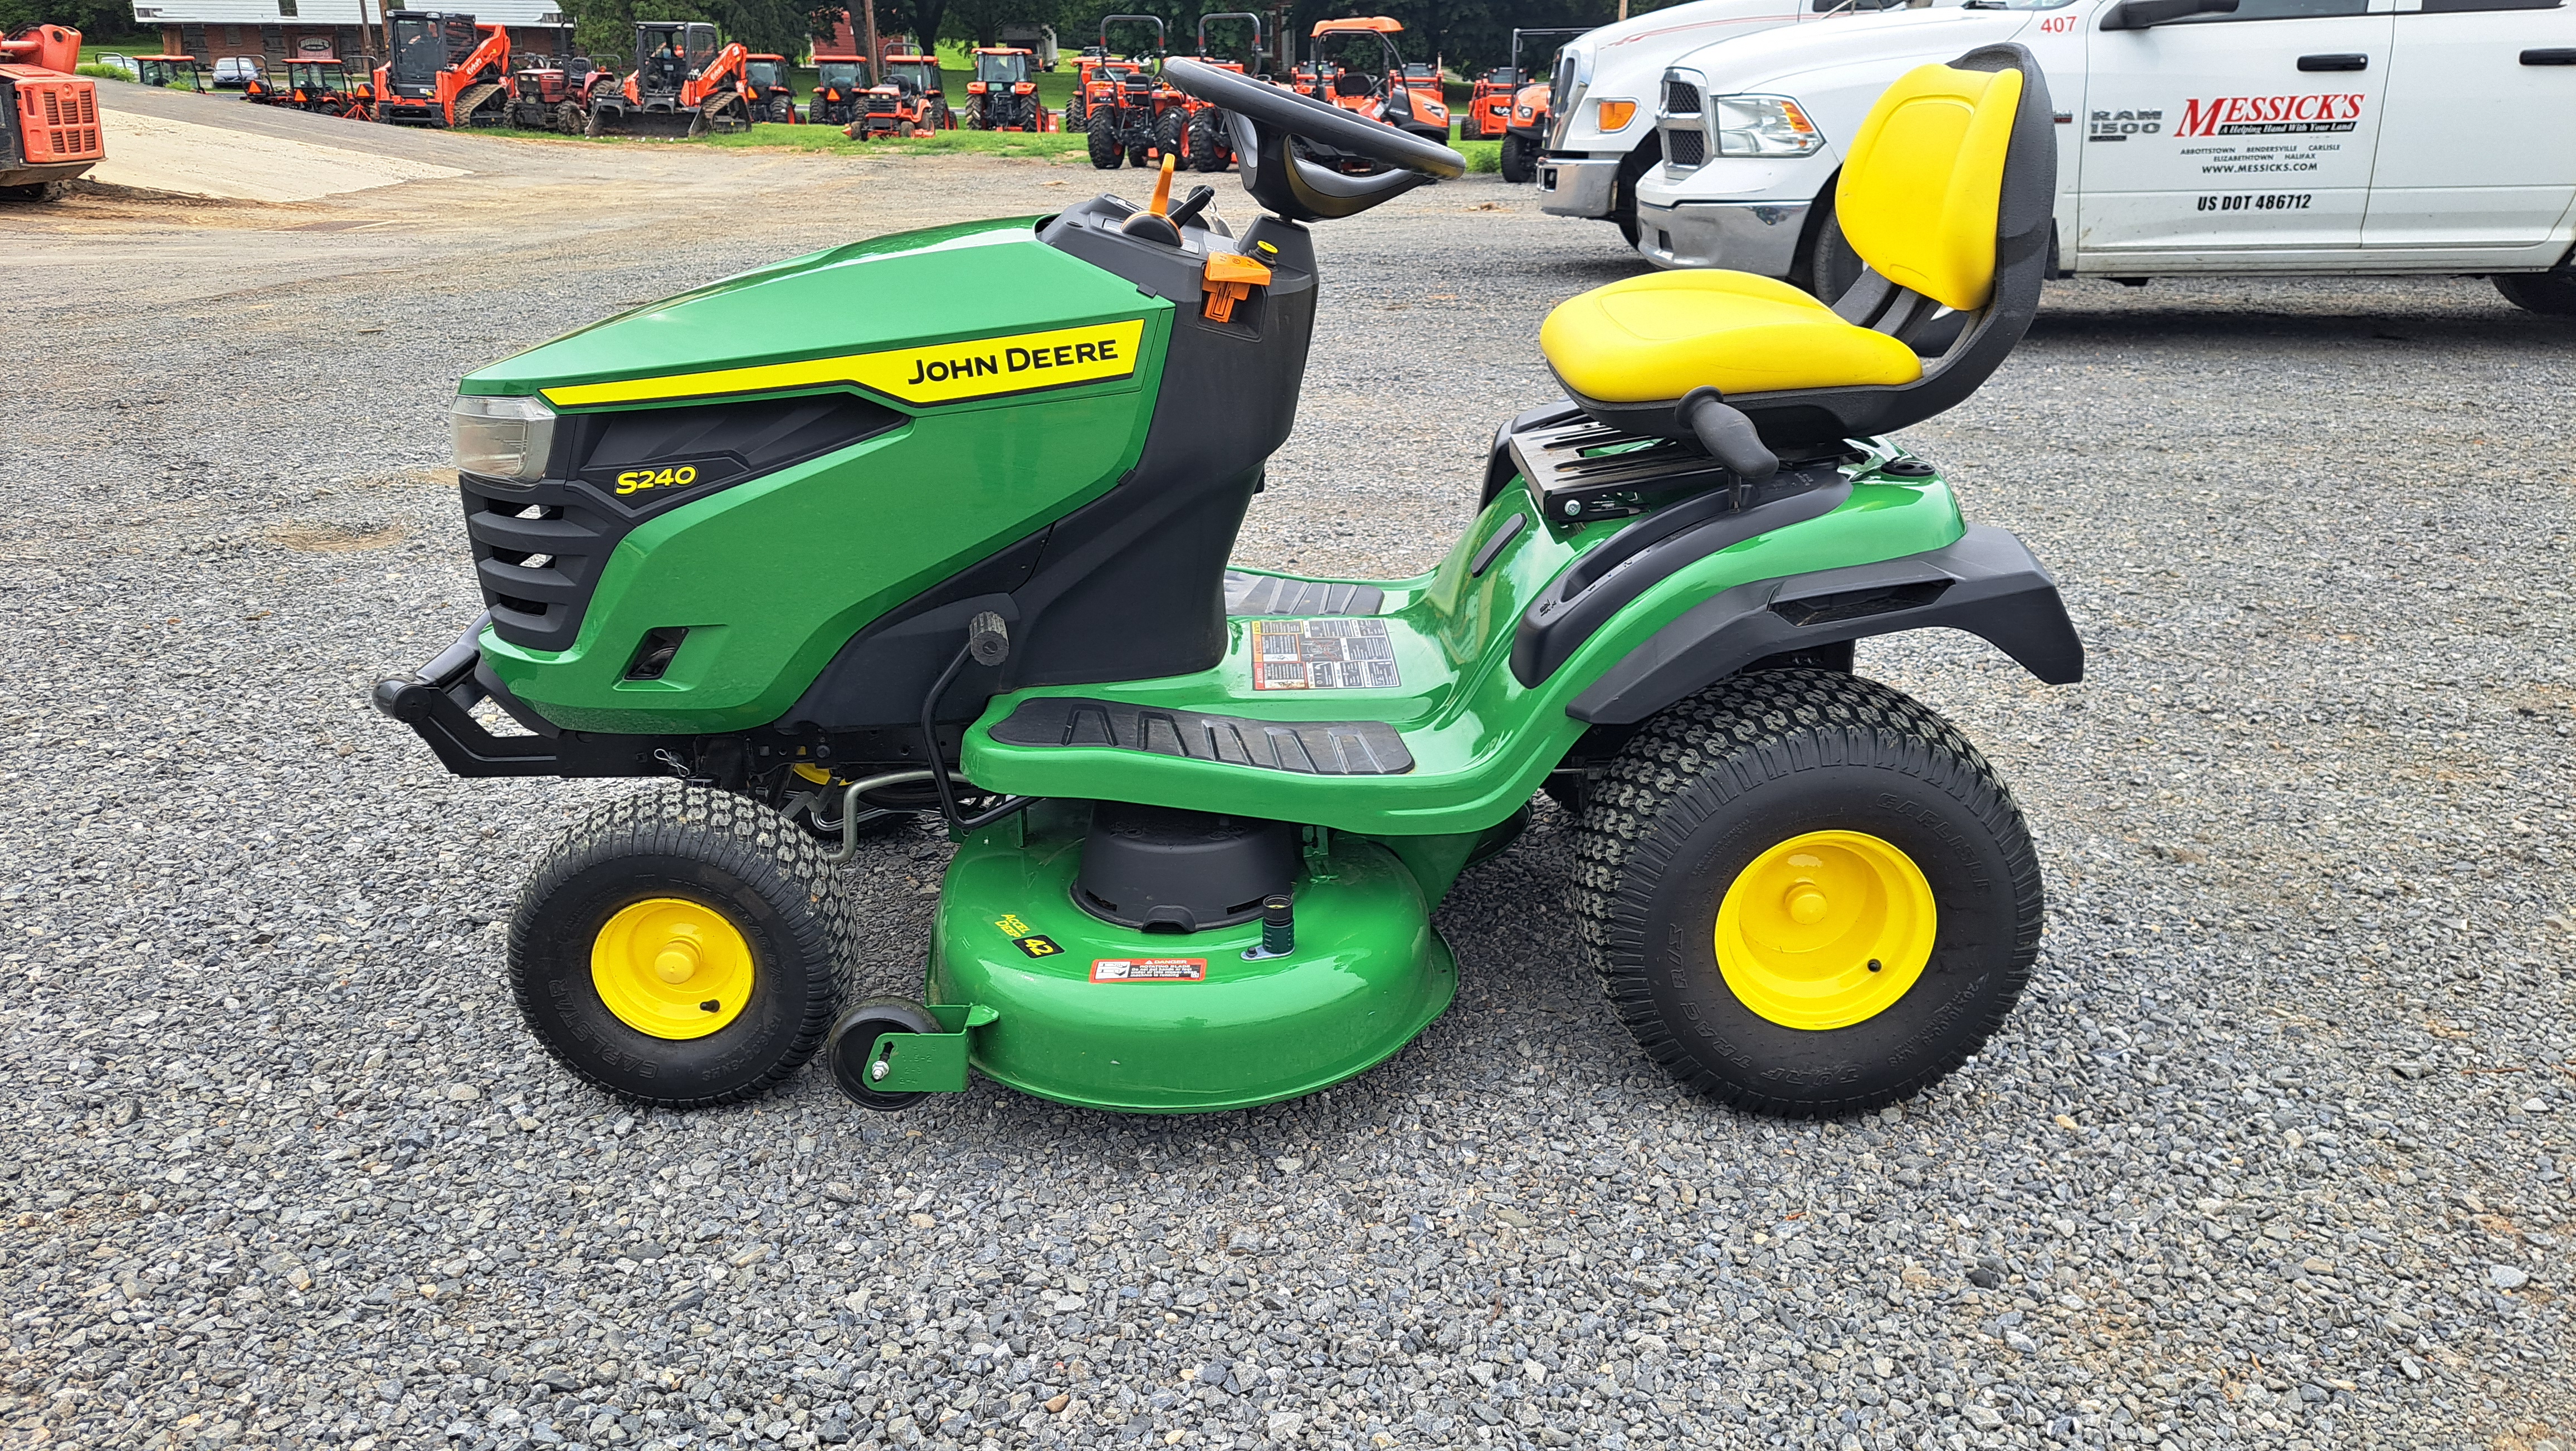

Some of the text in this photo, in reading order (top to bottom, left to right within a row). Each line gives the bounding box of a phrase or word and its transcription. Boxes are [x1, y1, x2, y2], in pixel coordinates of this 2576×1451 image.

[2040, 16, 2077, 33] 407
[2091, 109, 2163, 120] RAM
[2173, 94, 2366, 137] MESSICK'S
[2090, 123, 2162, 134] 1500
[2221, 121, 2353, 135] A Helping Hand With Your Land
[2213, 154, 2274, 162] ELIZABETHTOWN
[2246, 145, 2297, 154] BENDERSVILLE
[2202, 163, 2318, 174] WWW.MESSICKS.COM
[2197, 194, 2312, 211] US DOT 486712
[908, 339, 1119, 385] JOHN DEERE
[616, 466, 696, 494] S240
[994, 920, 1022, 937] DEEP
[1001, 914, 1031, 934] ACCEL
[1024, 939, 1053, 956] 42
[547, 978, 659, 1079] CARLSTAR
[1759, 1067, 1858, 1087] TURF
